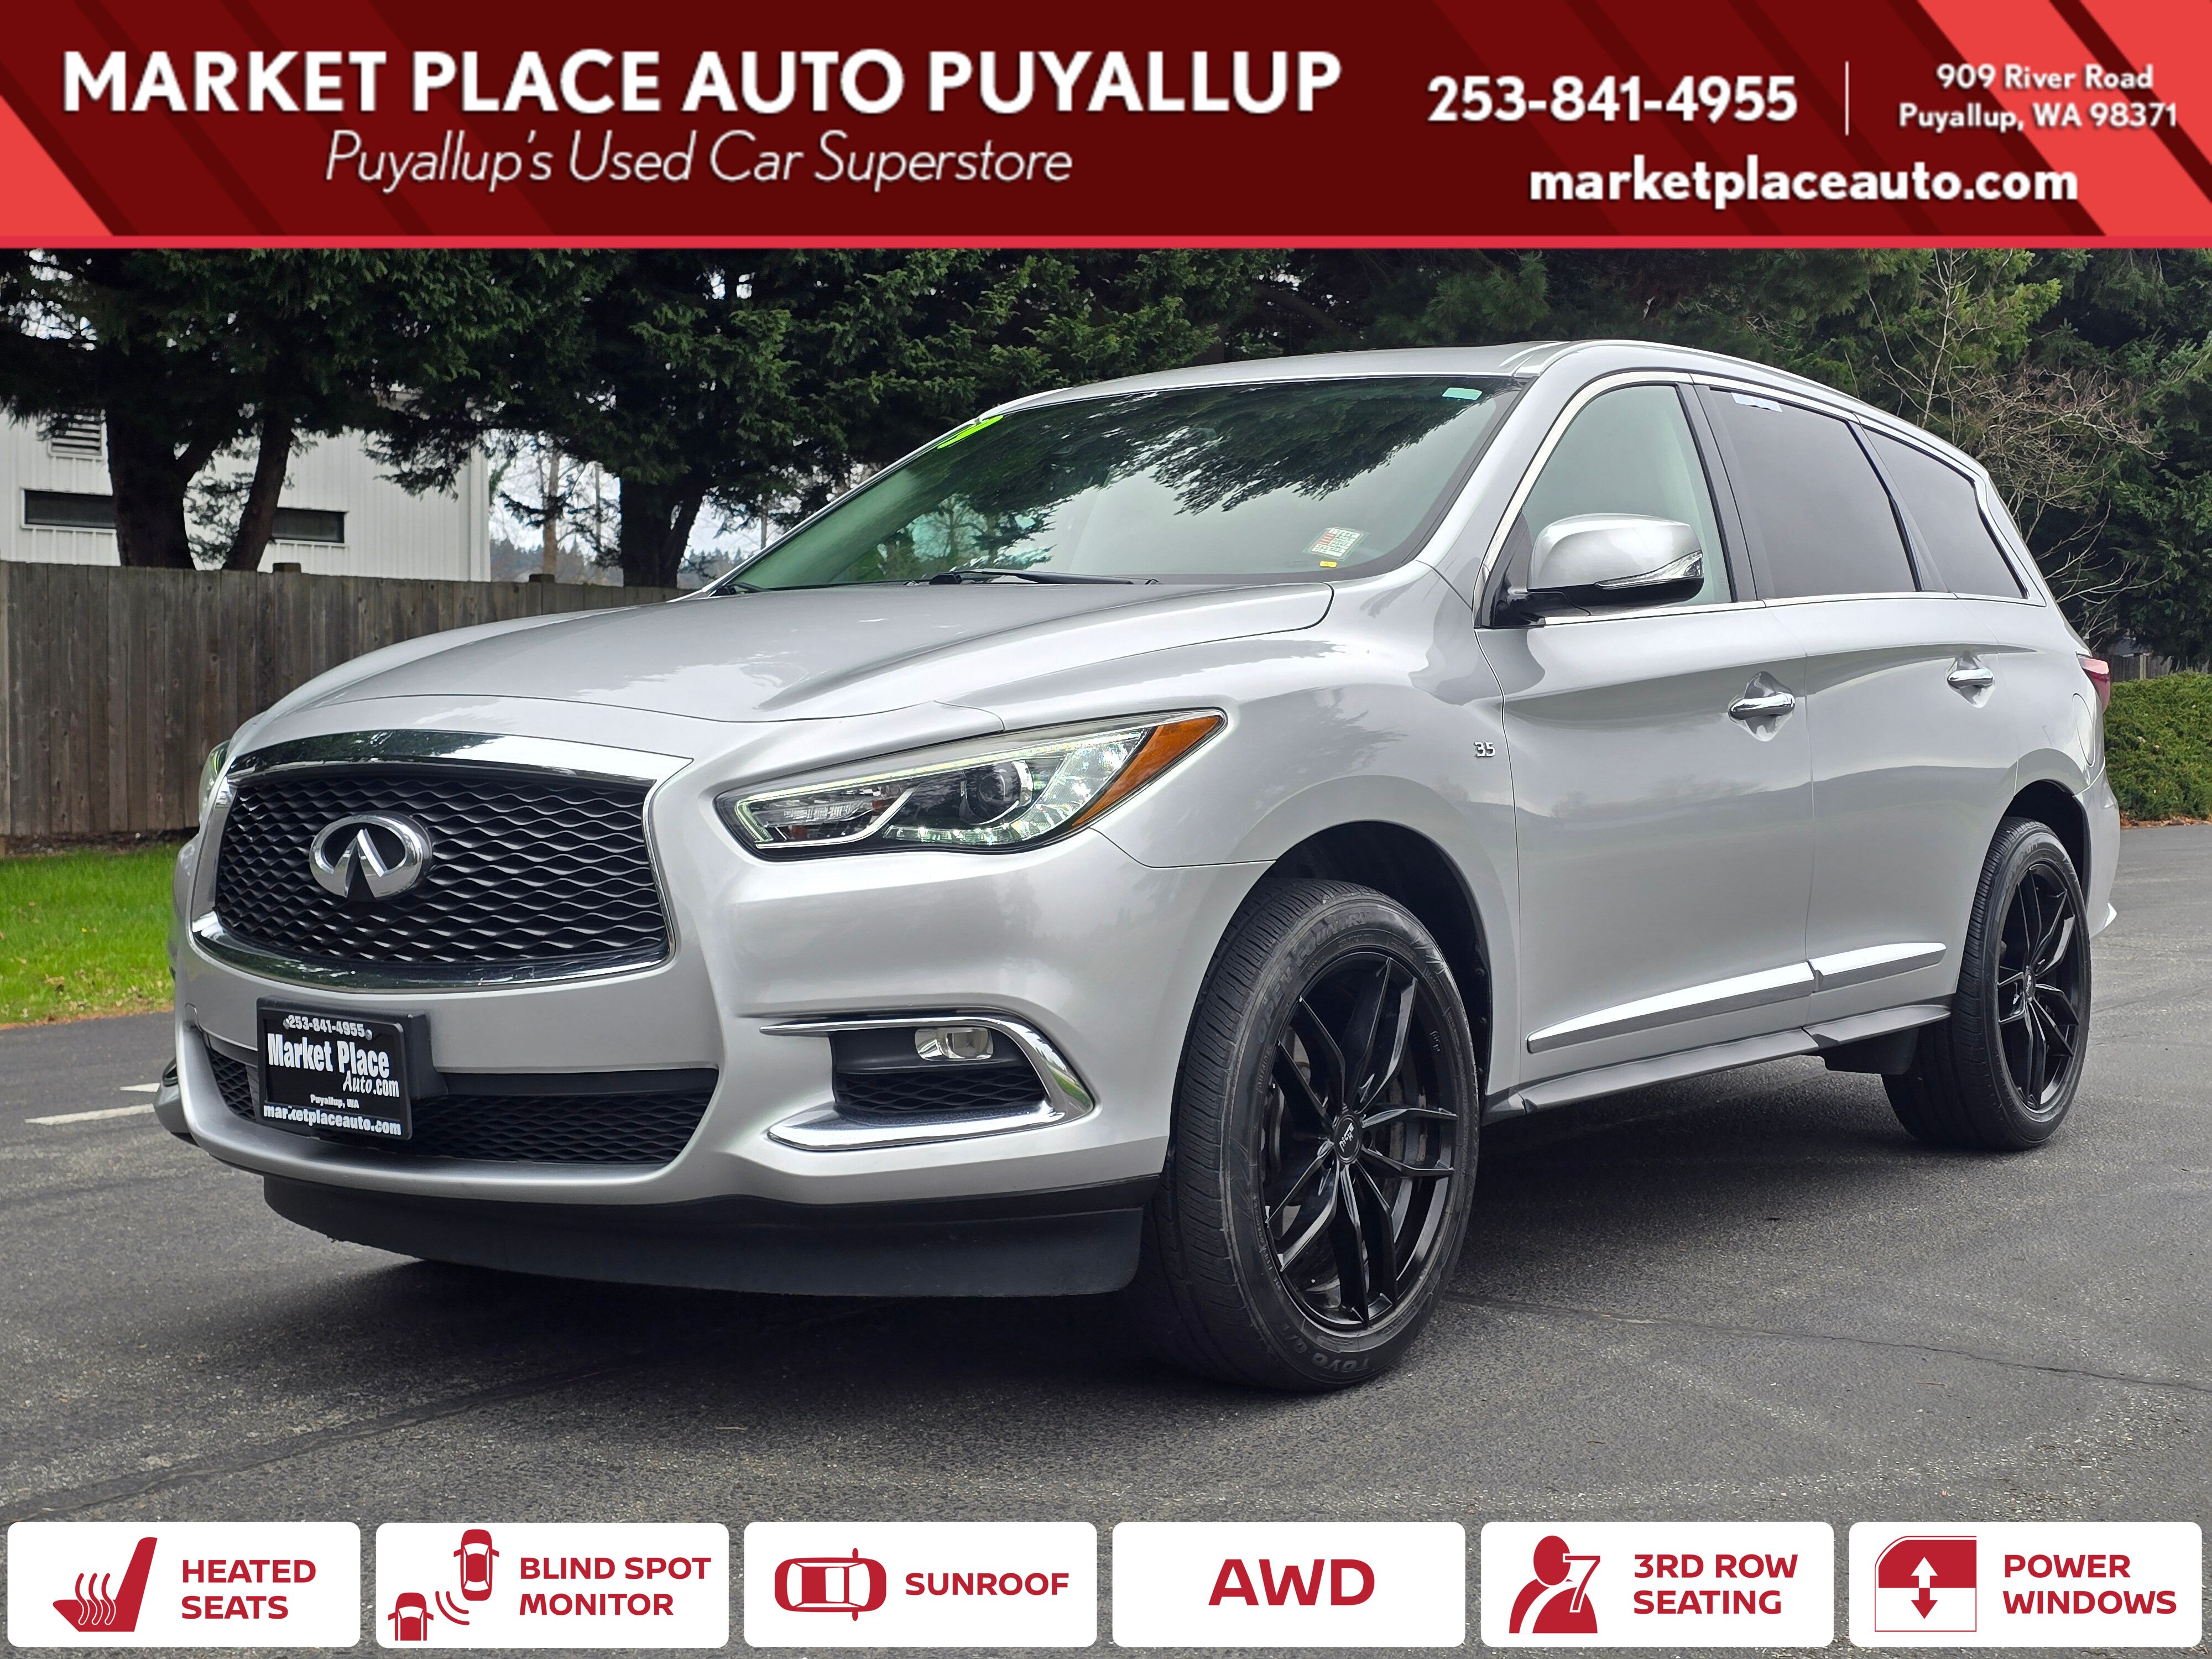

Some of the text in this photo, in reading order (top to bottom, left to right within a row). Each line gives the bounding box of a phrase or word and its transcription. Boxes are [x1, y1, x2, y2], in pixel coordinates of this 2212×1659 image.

[1474, 742, 1496, 757] 35
[288, 1014, 365, 1037] 253-841-4955
[267, 1033, 390, 1078] Market Place
[342, 1070, 399, 1097] Auto.com
[346, 1098, 359, 1109] WA
[263, 1105, 401, 1135] marketplaceauto.com
